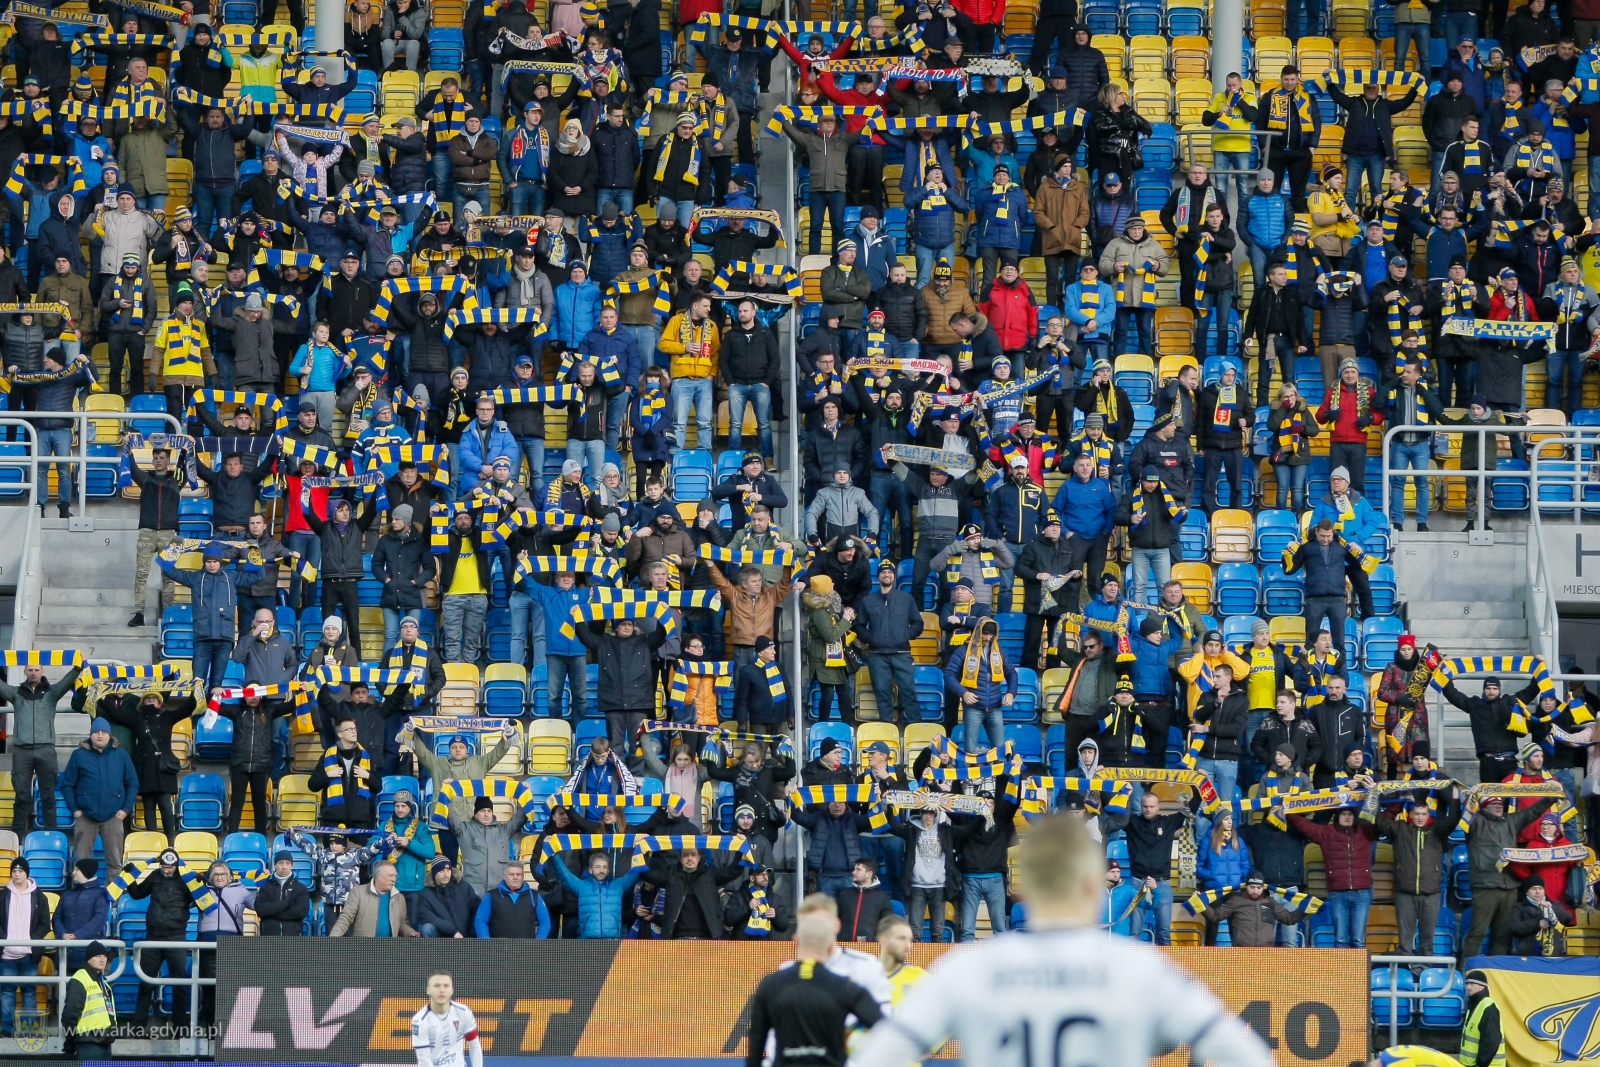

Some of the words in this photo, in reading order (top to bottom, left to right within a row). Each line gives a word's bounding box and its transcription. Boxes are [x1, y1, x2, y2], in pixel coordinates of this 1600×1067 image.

[15, 3, 47, 16] ARKA
[50, 9, 94, 22] GDYNIA
[831, 57, 894, 73] ARKA
[1476, 321, 1547, 338] ARKA
[1004, 399, 1020, 407] BET
[104, 537, 111, 547] 9
[1453, 550, 1459, 559] 9
[1463, 606, 1470, 615] 8
[101, 681, 152, 693] SINCE
[1146, 768, 1207, 787] GDYNIA
[1288, 796, 1336, 810] BRONIMY
[221, 987, 372, 1049] LV
